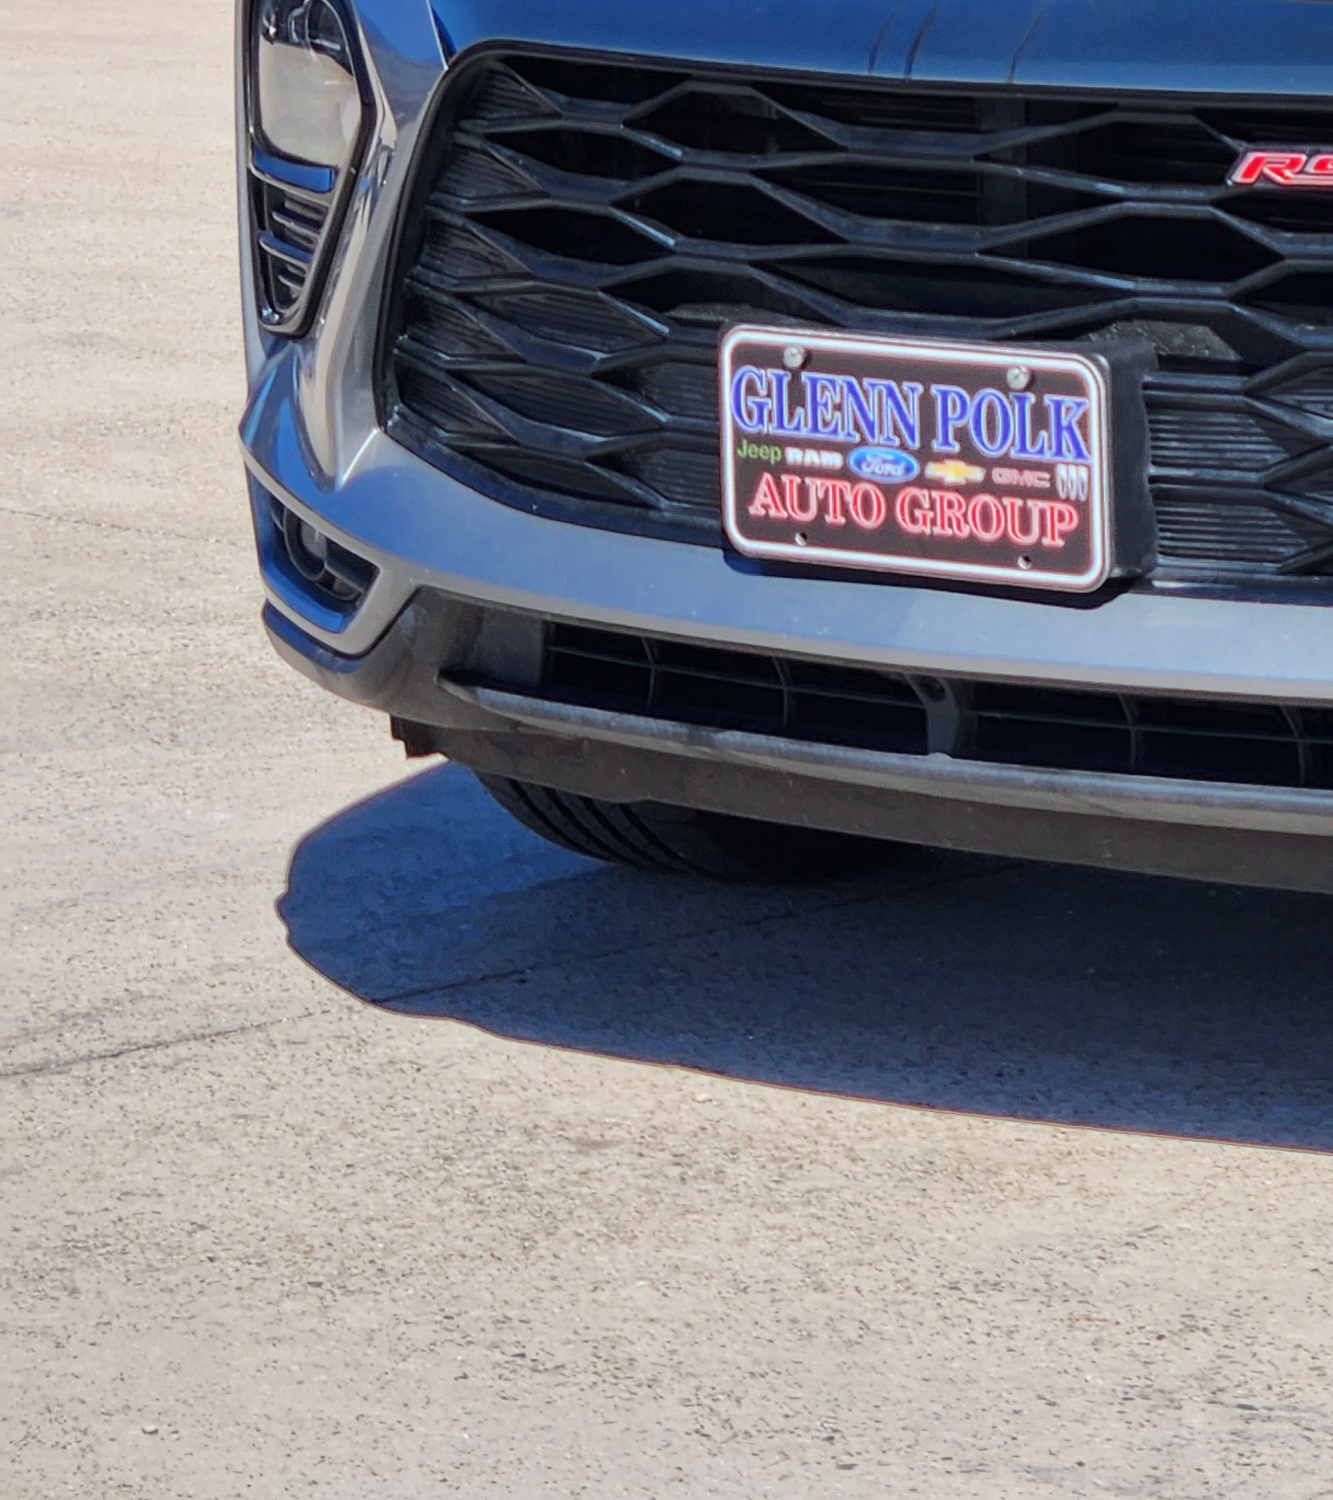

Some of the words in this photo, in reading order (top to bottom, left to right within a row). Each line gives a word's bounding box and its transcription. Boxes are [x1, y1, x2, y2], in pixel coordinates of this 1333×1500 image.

[730, 365, 924, 450] GLENN
[931, 384, 1093, 463] POLK
[736, 438, 783, 466] Jeep
[784, 446, 844, 471] RAM
[990, 466, 1051, 489] GMC
[747, 471, 888, 530] AUTO
[894, 485, 1080, 550] GROUP
